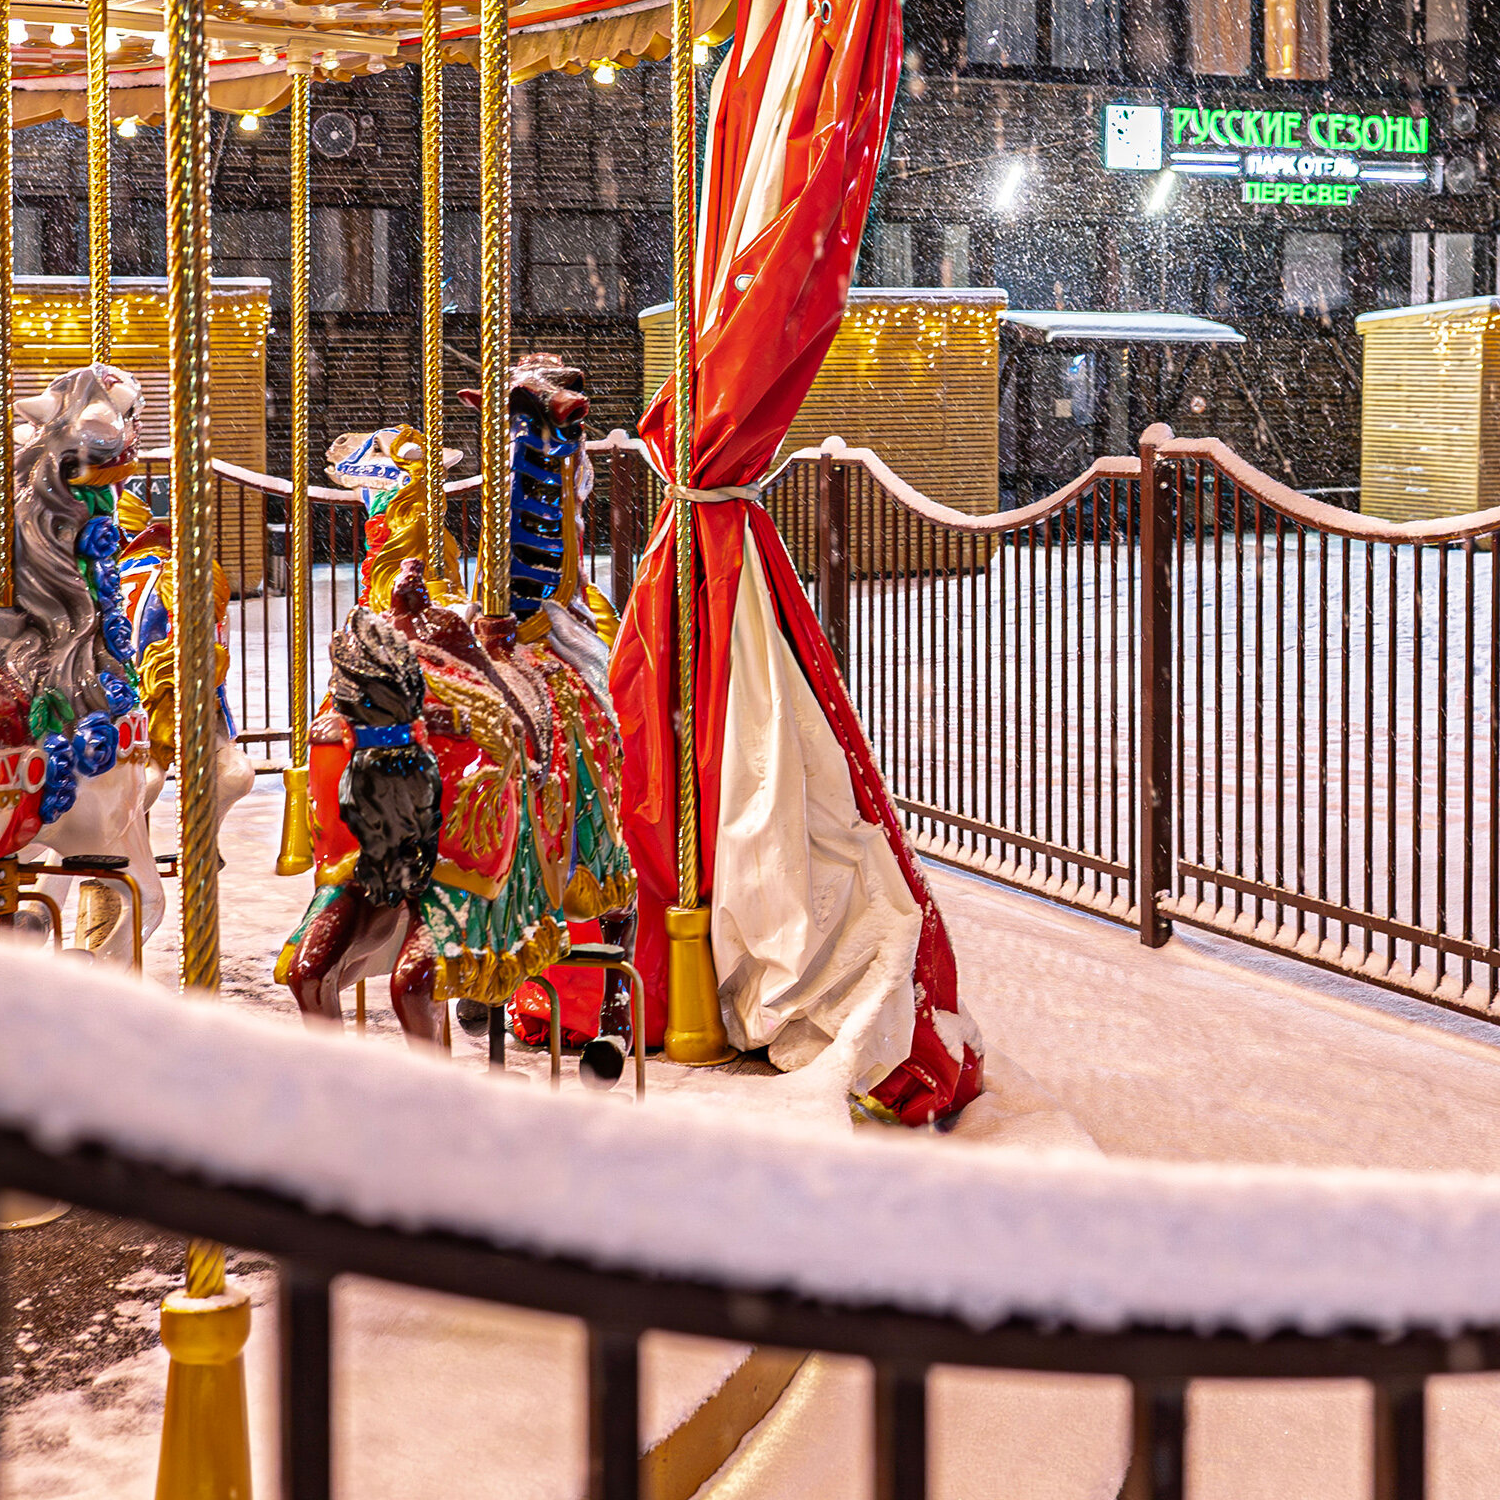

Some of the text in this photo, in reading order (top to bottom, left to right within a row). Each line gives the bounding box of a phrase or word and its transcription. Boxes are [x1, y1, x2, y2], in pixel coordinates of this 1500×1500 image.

[1173, 107, 1429, 153] РУССКИЕ СЕЗОНЫ
[1246, 155, 1360, 177] ПАРК ОТЕЛЬ
[1243, 181, 1361, 205] ПЕРЕСВЕТ
